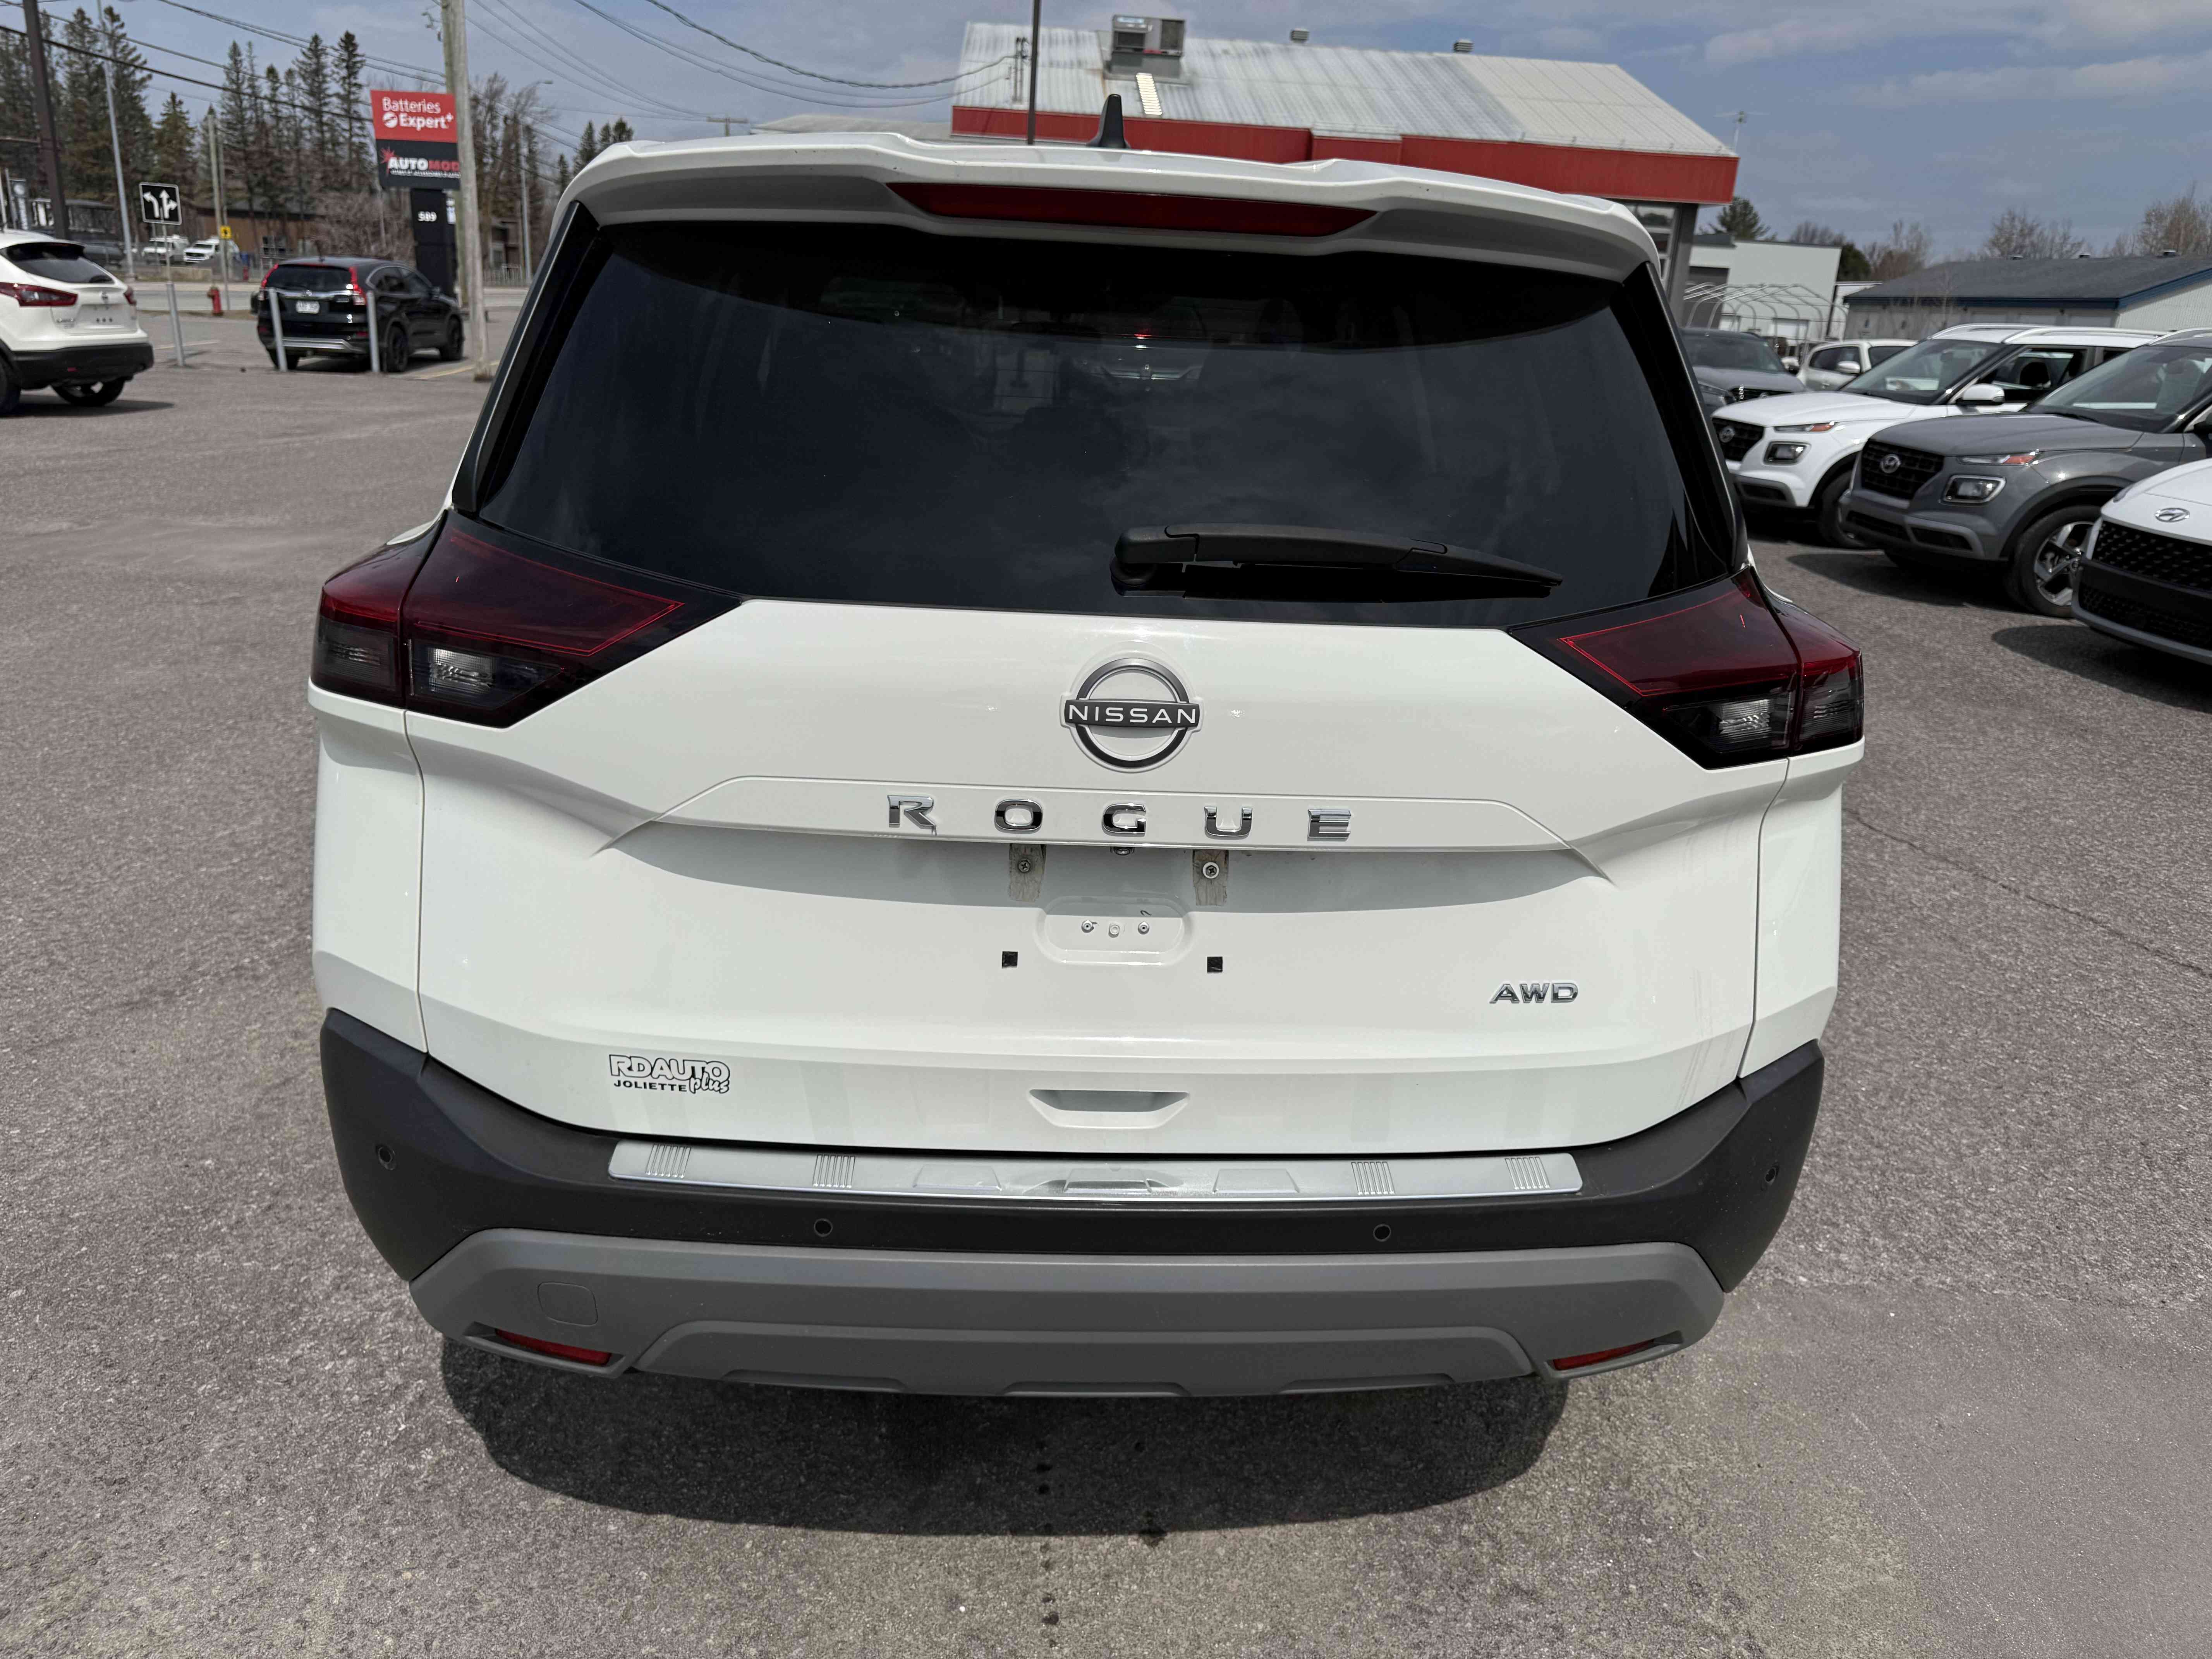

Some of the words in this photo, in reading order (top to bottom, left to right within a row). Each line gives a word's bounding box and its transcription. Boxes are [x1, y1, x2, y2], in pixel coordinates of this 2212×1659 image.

[382, 96, 441, 114] Batteries
[1069, 704, 1196, 724] NISSAN
[887, 794, 1352, 840] ROGUE
[1489, 982, 1578, 1004] AWD
[614, 1080, 687, 1092] JOLIETTE
[689, 1071, 730, 1094] plus
